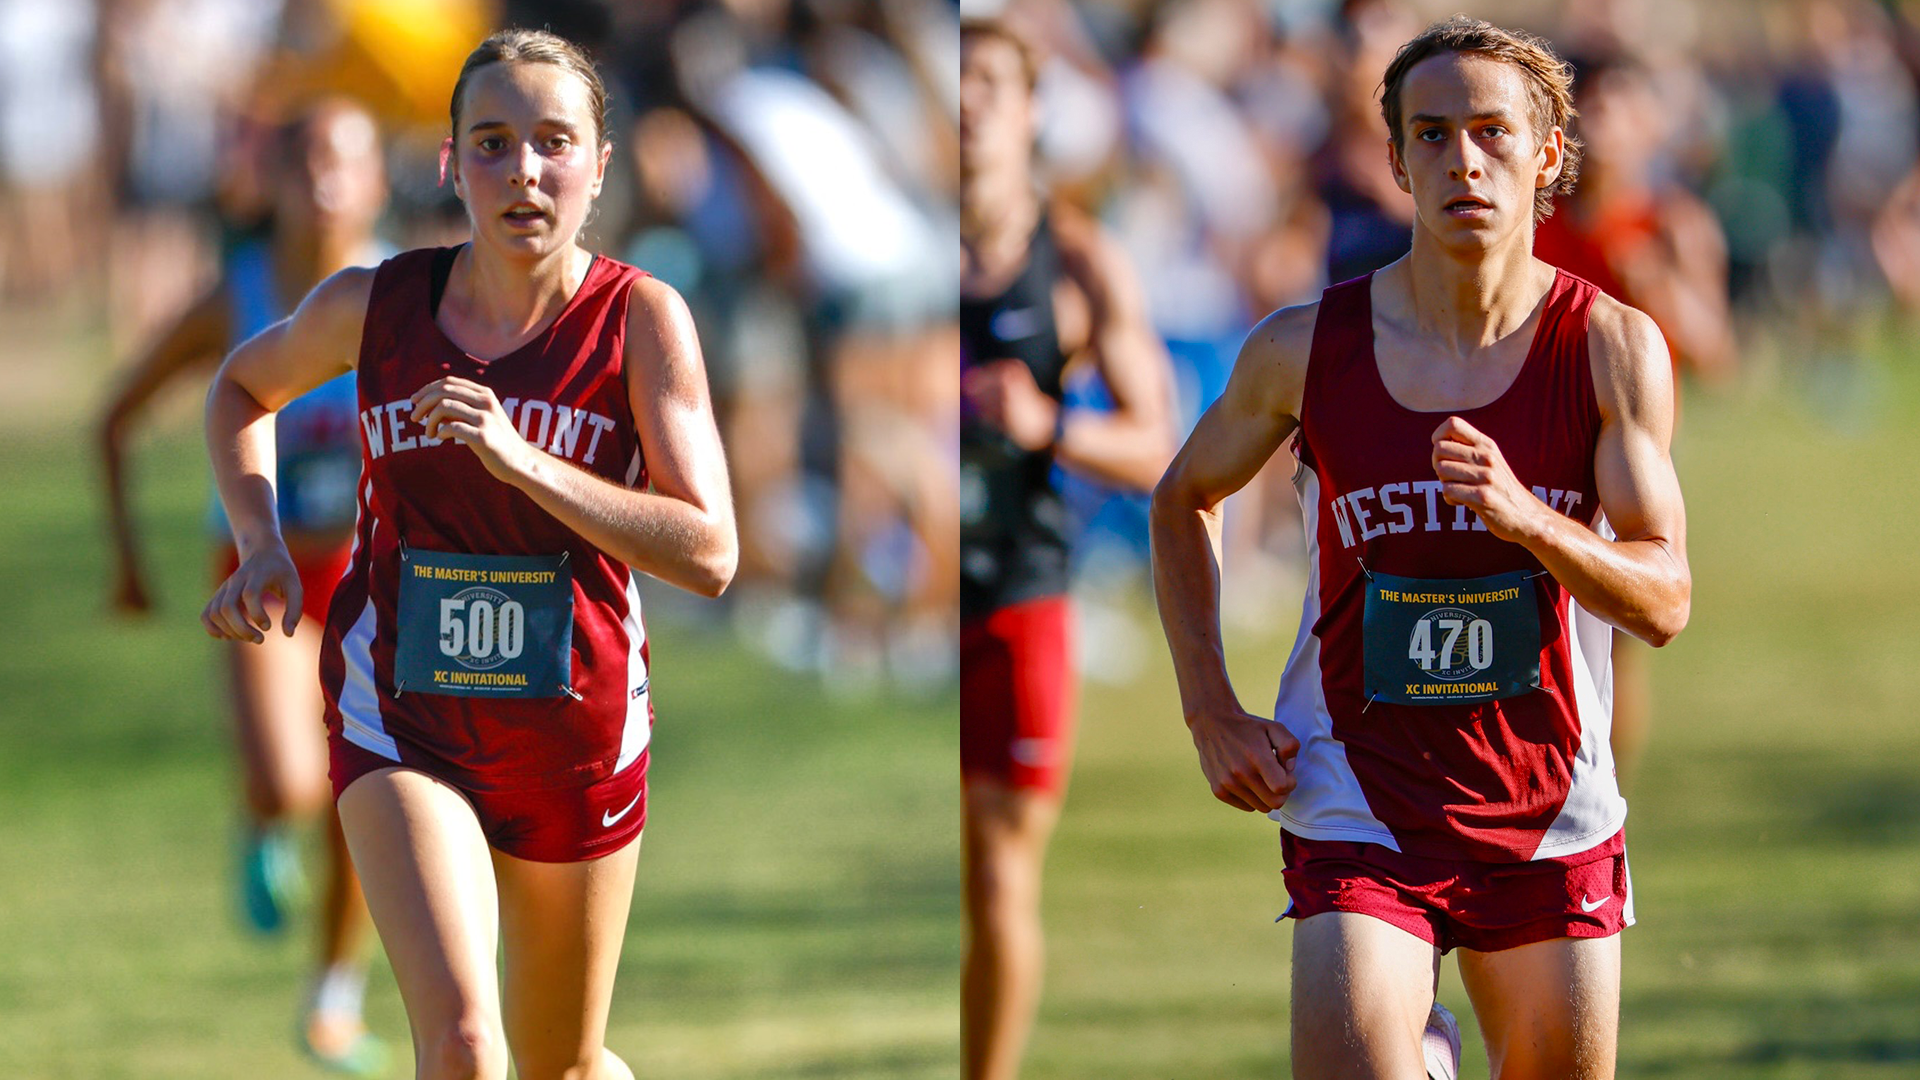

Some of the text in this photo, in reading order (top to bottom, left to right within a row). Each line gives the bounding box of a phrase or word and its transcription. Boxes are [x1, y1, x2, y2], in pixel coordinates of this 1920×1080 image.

[414, 565, 555, 583] THE MASTER'S UNIVERSITY
[1380, 587, 1520, 604] THE MASTER'S UNIVERSITY
[439, 598, 524, 659] 500
[1408, 619, 1493, 670] 470
[434, 670, 528, 685] XC INVITATIONAL
[1405, 682, 1499, 694] XC INVITATIONAL
